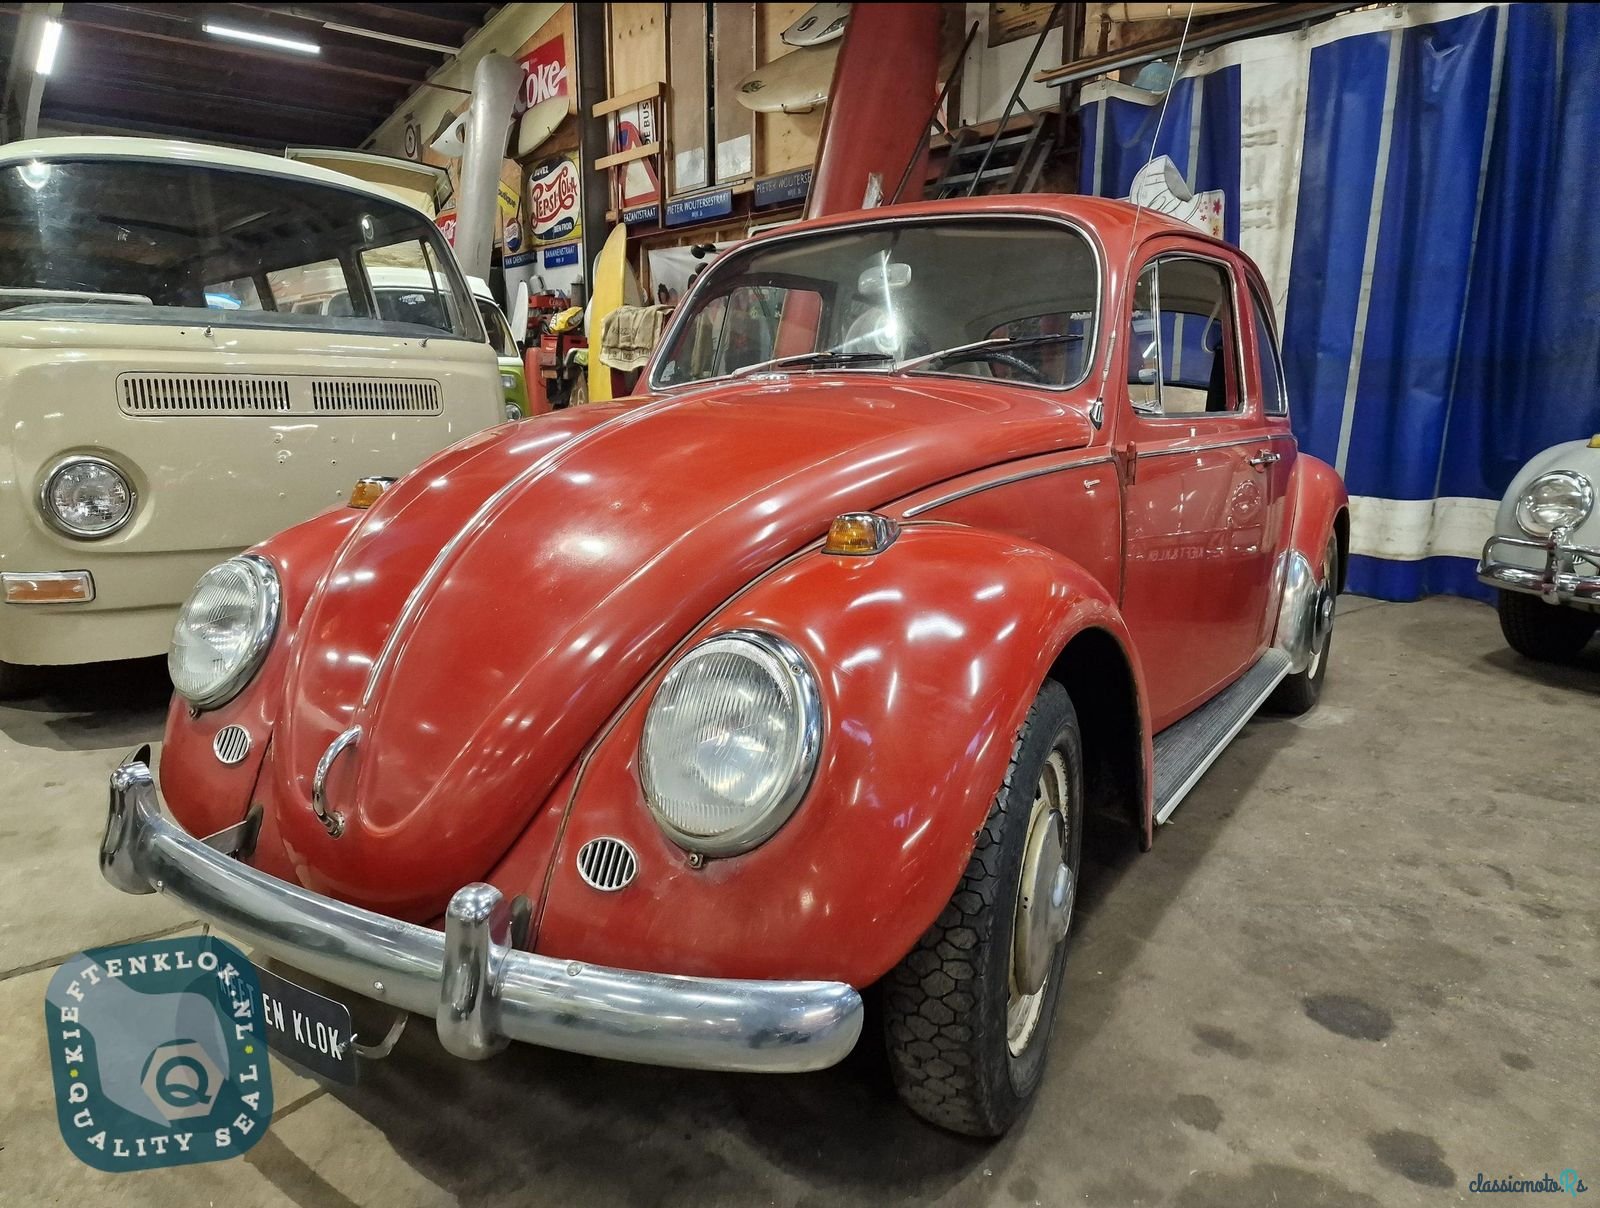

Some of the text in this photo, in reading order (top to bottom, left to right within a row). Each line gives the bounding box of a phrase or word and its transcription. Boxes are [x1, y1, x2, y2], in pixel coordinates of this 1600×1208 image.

[642, 102, 651, 127] BUS
[667, 192, 730, 216] PIETER WOUTERSESTRAAT
[262, 992, 285, 1033] EN
[292, 1009, 343, 1061] KLOK
